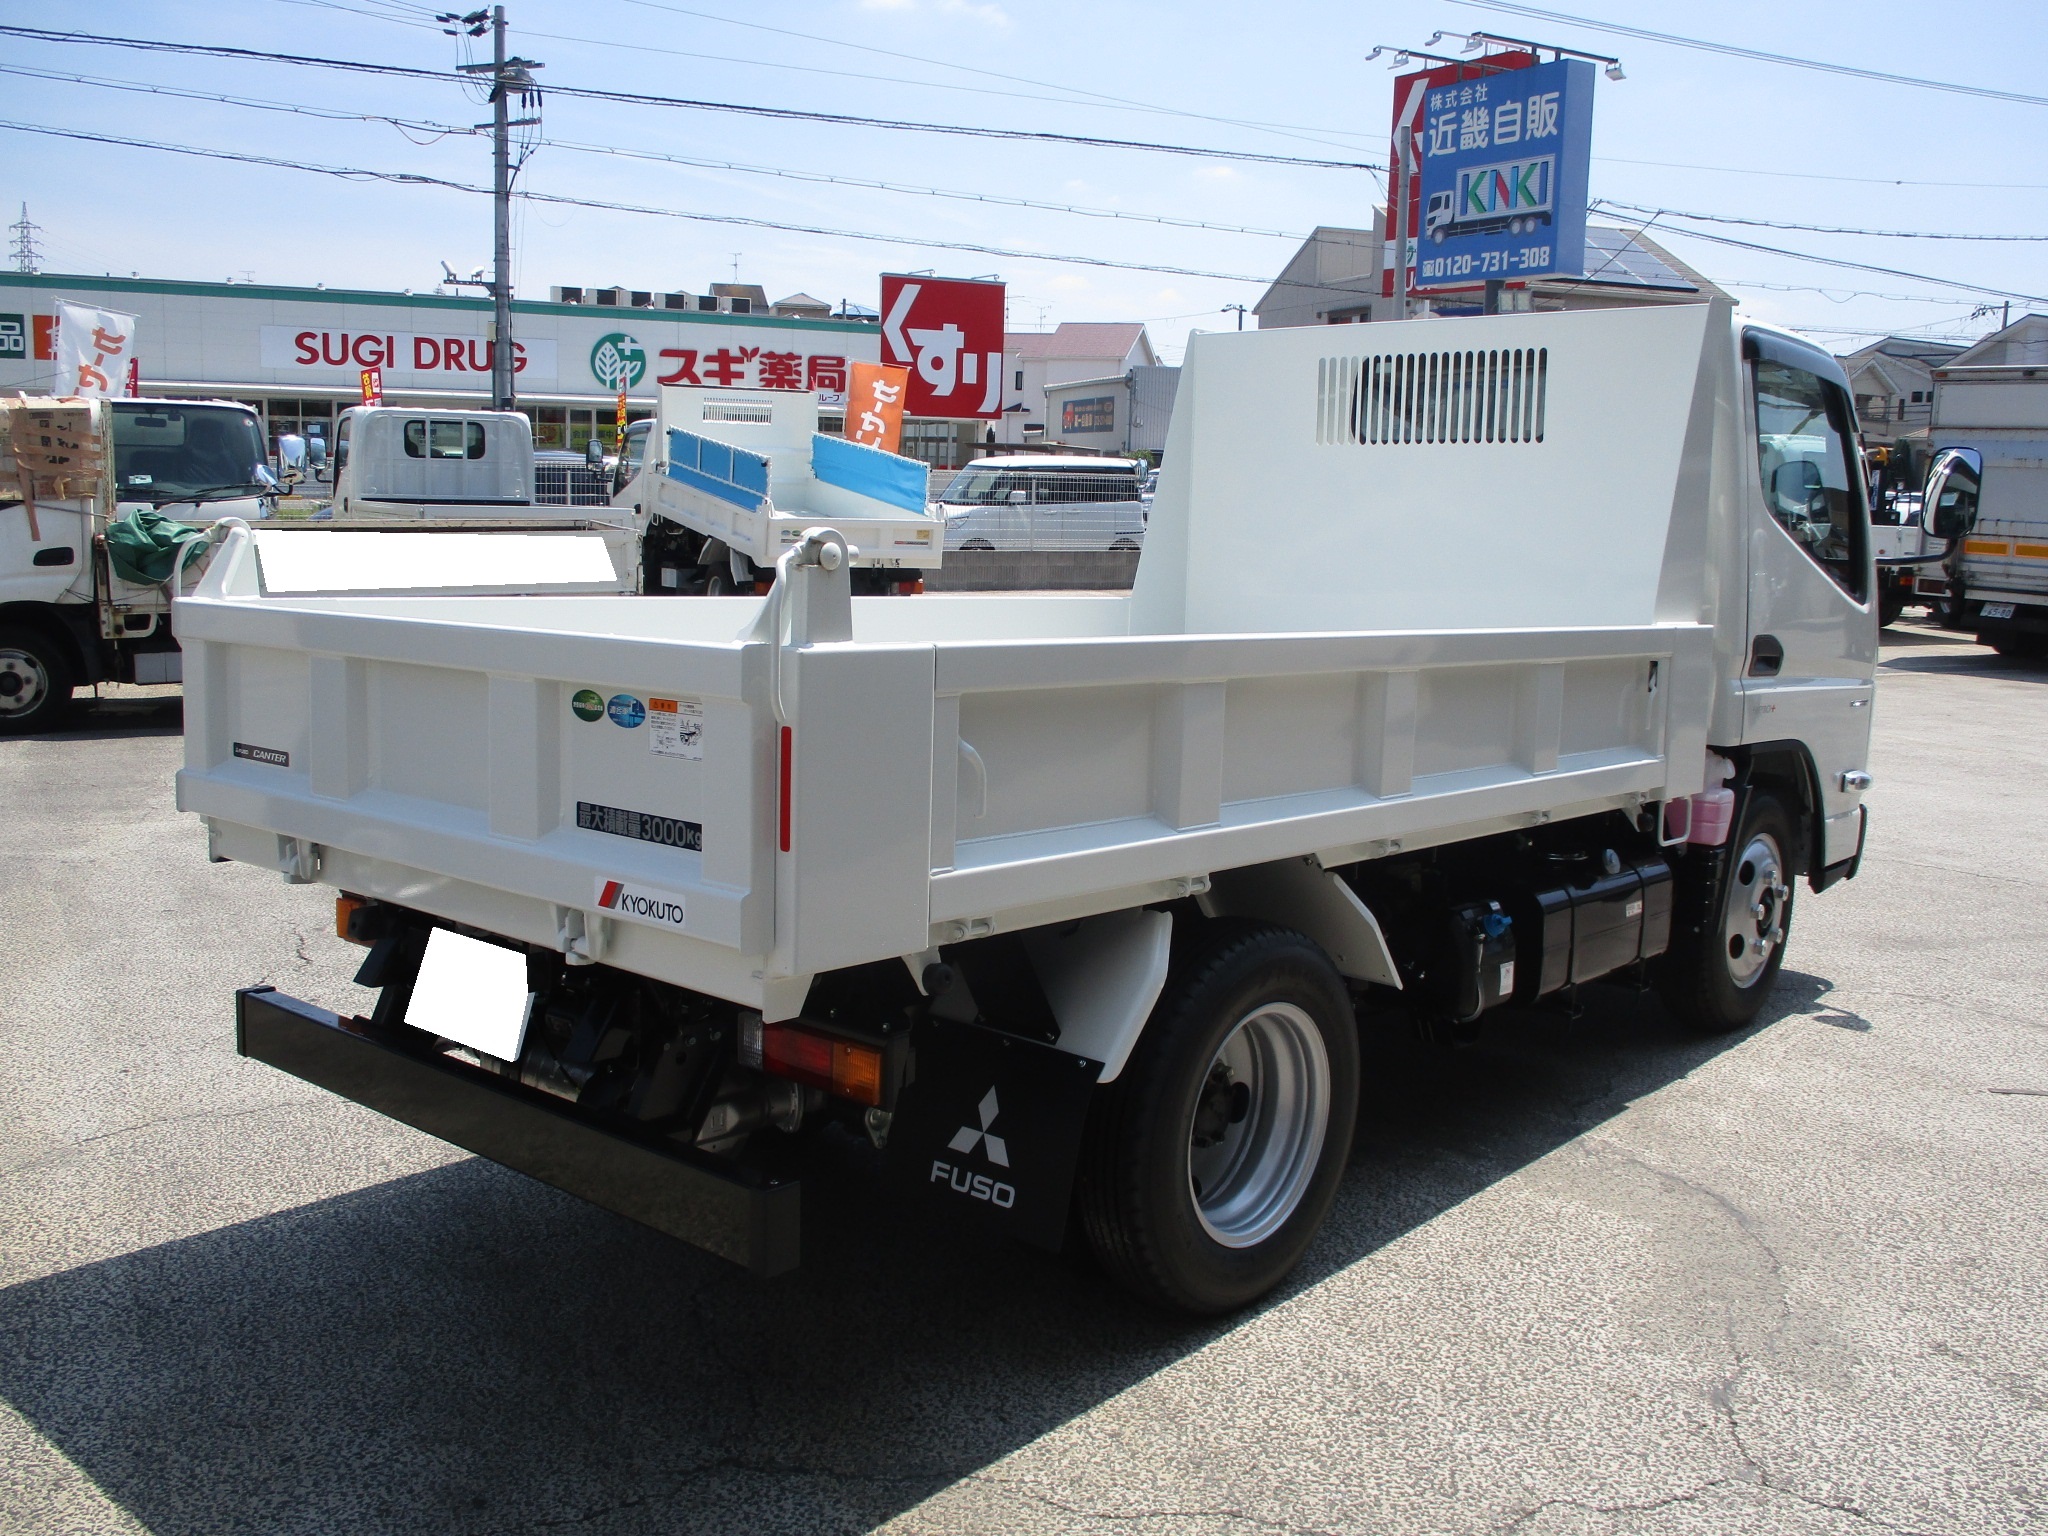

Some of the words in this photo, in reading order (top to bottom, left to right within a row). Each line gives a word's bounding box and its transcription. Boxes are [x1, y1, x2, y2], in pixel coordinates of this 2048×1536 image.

[1430, 83, 1488, 112] 株式会社
[1427, 91, 1560, 158] 近畿自販
[1435, 246, 1550, 277] 0120-731-308
[294, 331, 394, 369] SUGI
[882, 283, 1002, 413] くすり
[657, 345, 846, 393] スギ薬局
[253, 749, 287, 763] CANTER
[621, 893, 684, 924] KYOKUTO
[930, 1160, 1015, 1208] FUSO
